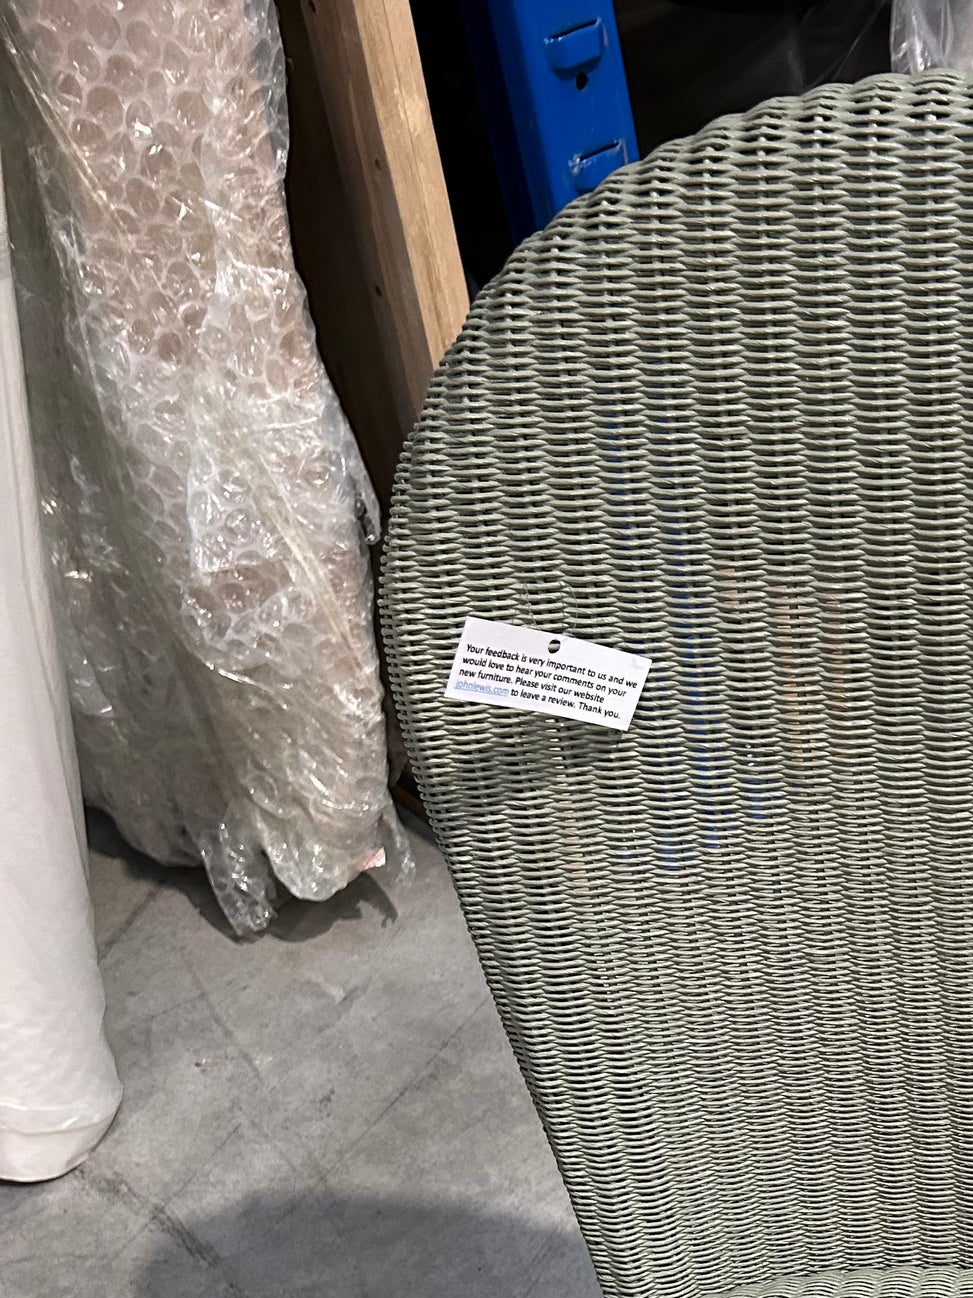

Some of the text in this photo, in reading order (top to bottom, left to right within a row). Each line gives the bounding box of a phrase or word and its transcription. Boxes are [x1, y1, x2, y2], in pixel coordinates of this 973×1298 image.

[459, 669, 605, 703] new furniture. Please visit our website
[462, 657, 627, 697] would love to hear your comments on your
[467, 644, 638, 689] Your feedback is very important to us and we
[454, 681, 509, 696] johnlewis.com
[511, 689, 519, 697] to
[520, 689, 540, 700] leave
[548, 696, 576, 708] review.
[579, 702, 602, 714] Thank
[603, 709, 620, 719] you.
